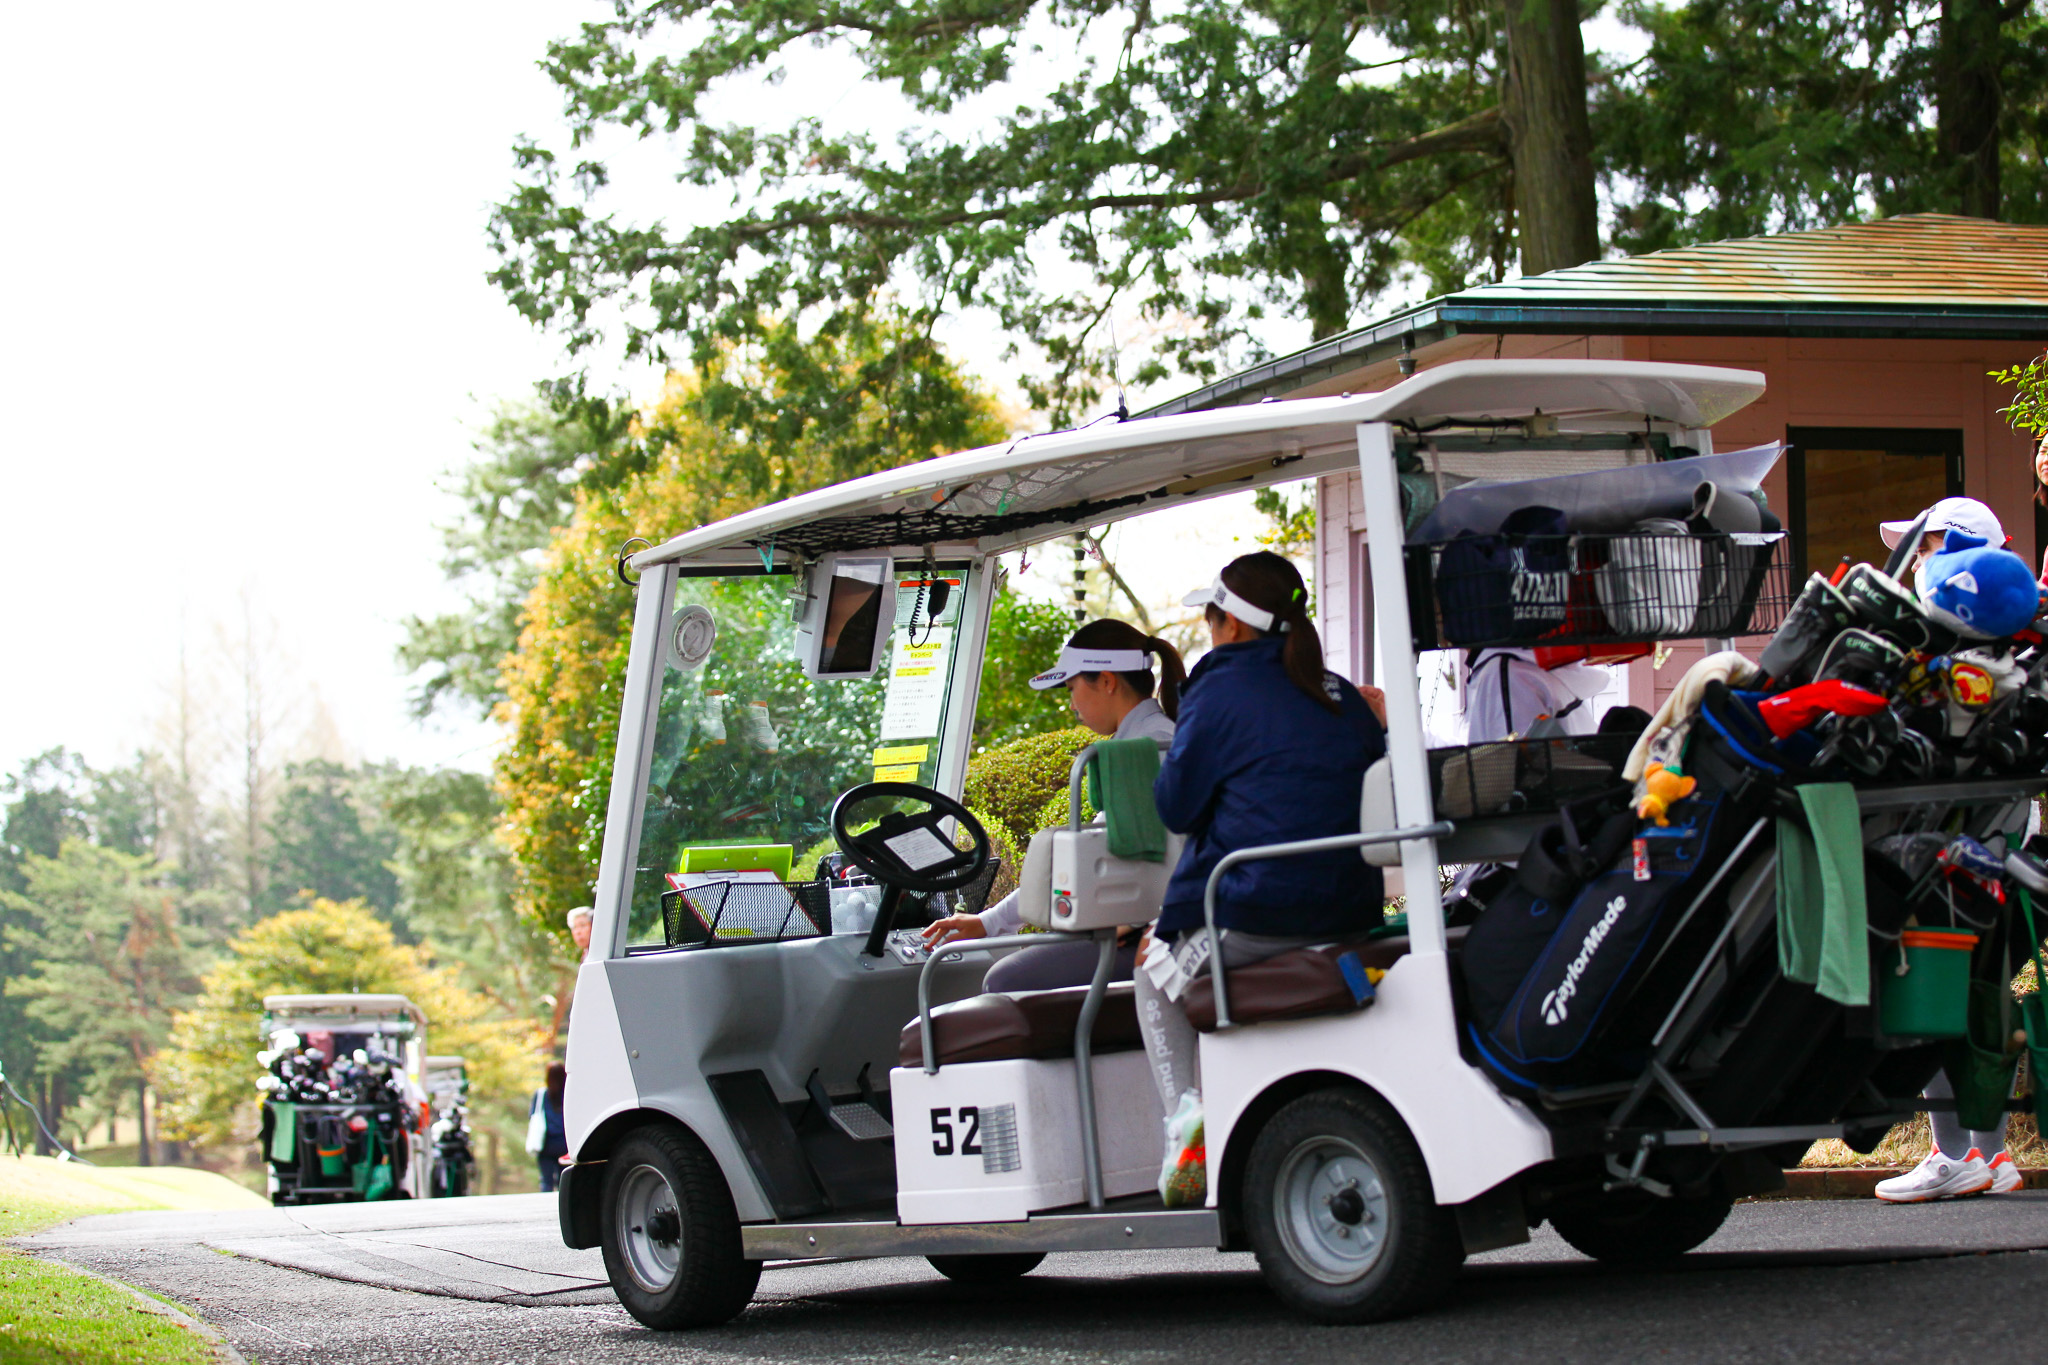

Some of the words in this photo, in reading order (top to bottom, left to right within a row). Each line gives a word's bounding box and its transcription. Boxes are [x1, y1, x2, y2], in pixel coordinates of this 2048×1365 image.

[1945, 521, 1977, 535] APEX
[1853, 577, 1887, 606] EPIC
[1845, 637, 1877, 653] EPIC
[1541, 895, 1627, 1026] TaylorMade
[1146, 998, 1162, 1022] se
[1151, 1027, 1173, 1059] per
[1157, 1061, 1177, 1098] and
[930, 1106, 983, 1156] 52
